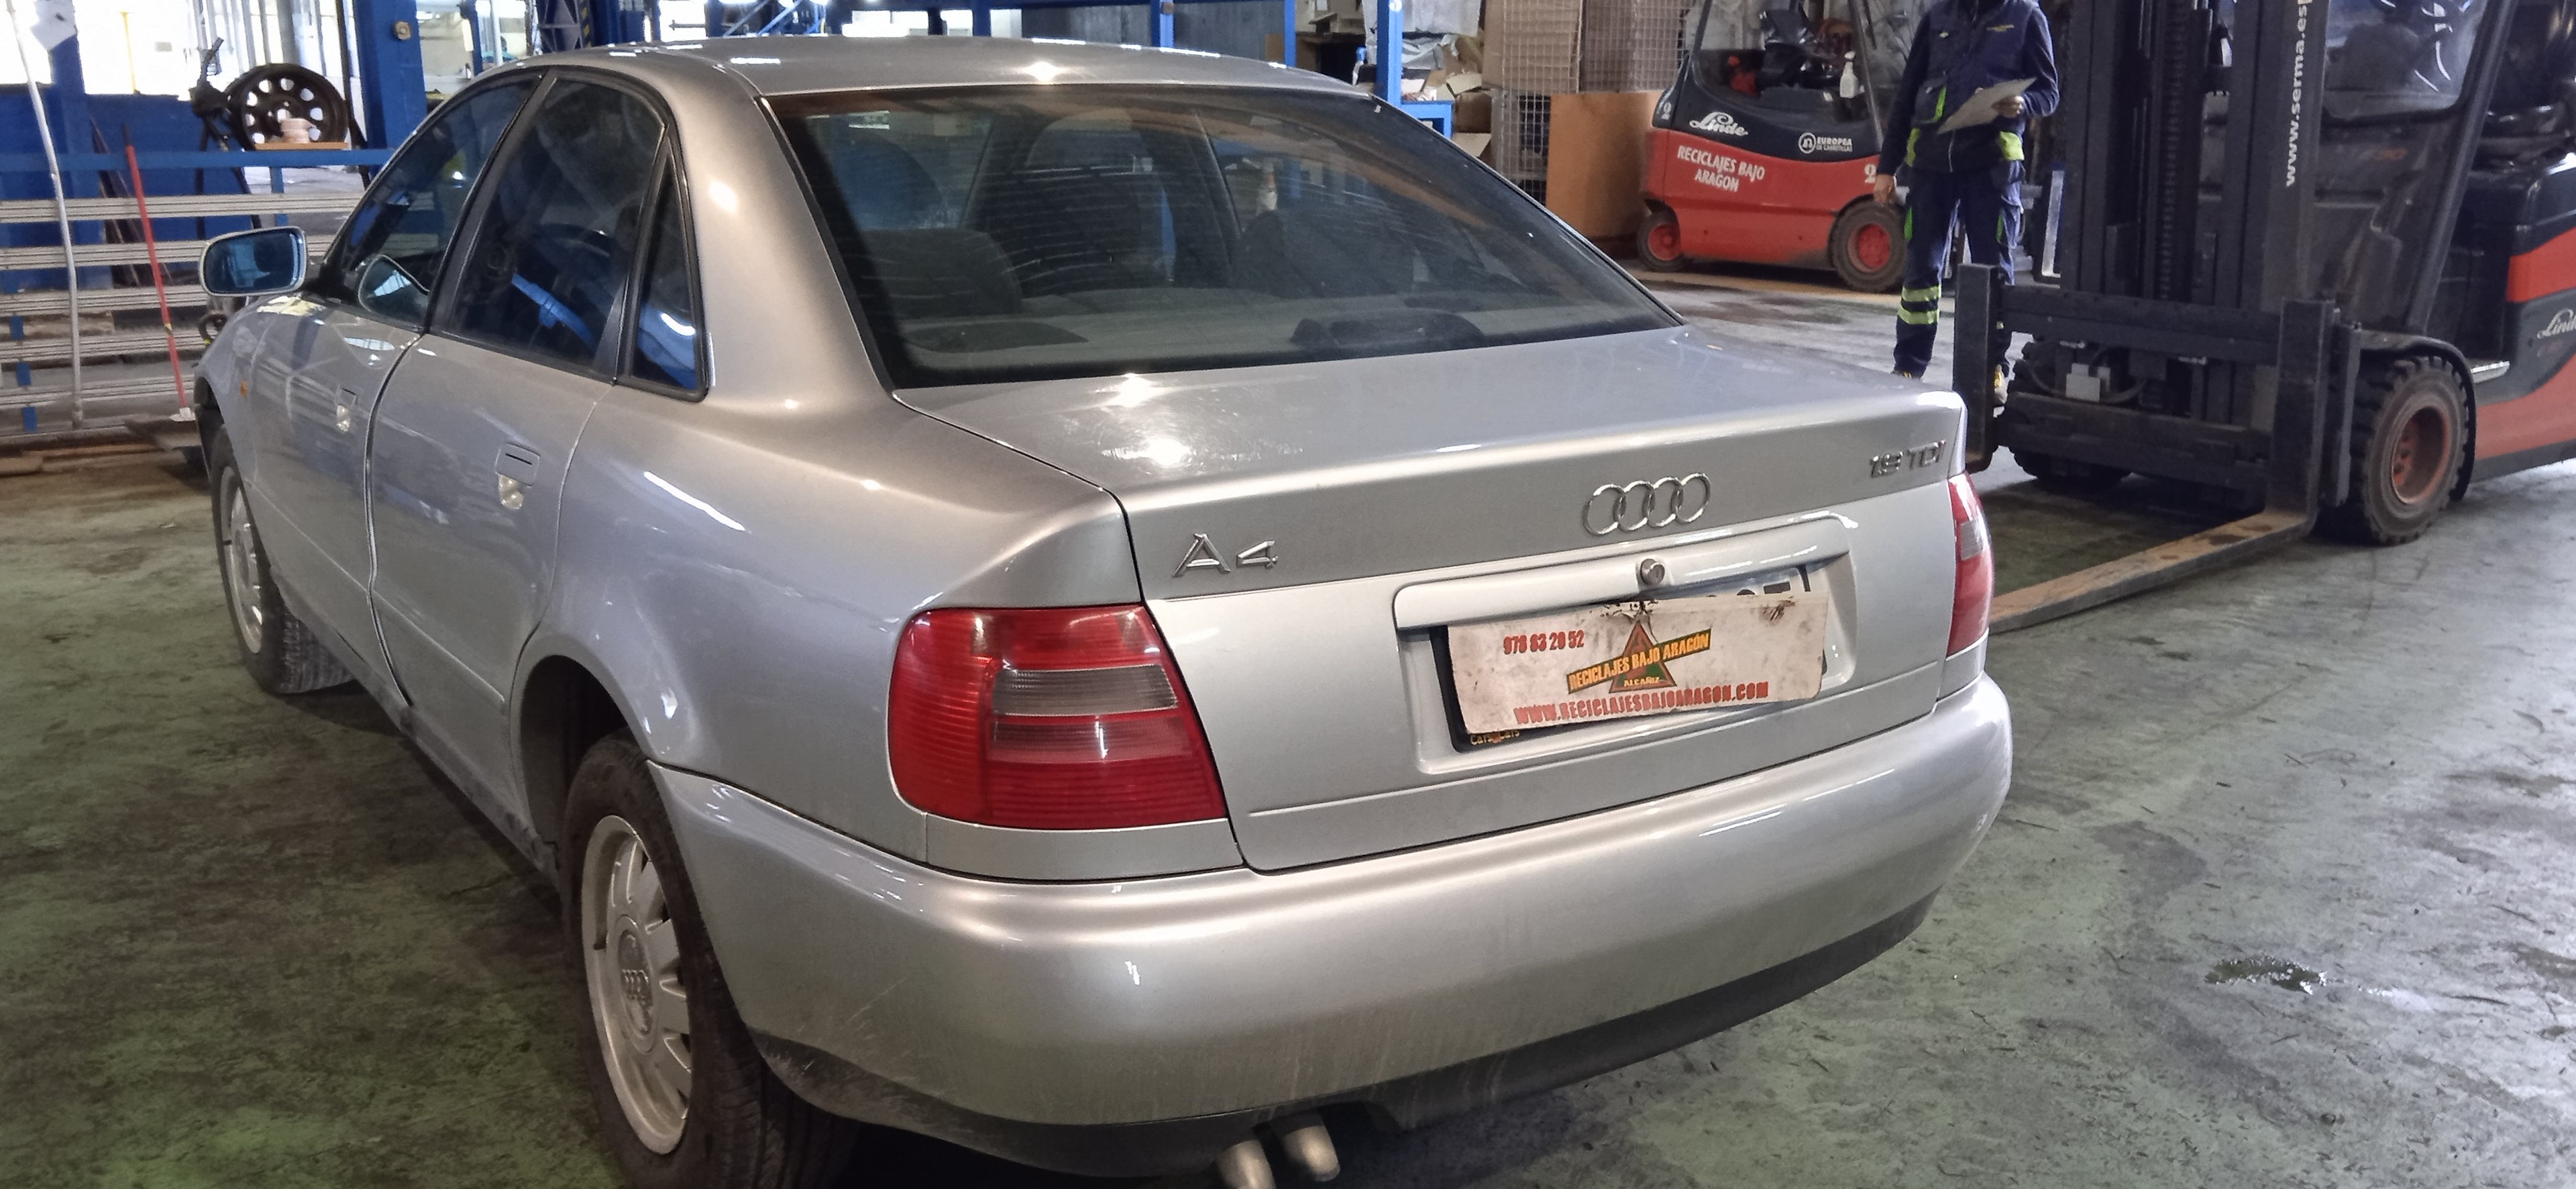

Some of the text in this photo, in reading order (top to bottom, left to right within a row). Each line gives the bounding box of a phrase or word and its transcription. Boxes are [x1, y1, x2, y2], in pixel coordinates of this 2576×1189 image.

[2286, 5, 2308, 188] www.serma.es
[1688, 111, 1749, 137] Linde
[1815, 136, 1853, 146] EUROPEA
[1677, 145, 1766, 183] RECICLAJES BAJO
[1694, 168, 1739, 193] ARAGON
[1906, 440, 1945, 470] TDI
[1173, 533, 1279, 578] A4
[1549, 631, 1566, 651] 20
[1568, 629, 1585, 649] 52
[1568, 656, 1631, 690] RECICLAJES
[1631, 647, 1661, 670] BAJO
[1623, 676, 1660, 688] ALCAÑIZ
[1513, 681, 1769, 725] WWW.RECICLAJESBAJOARAGON.COM
